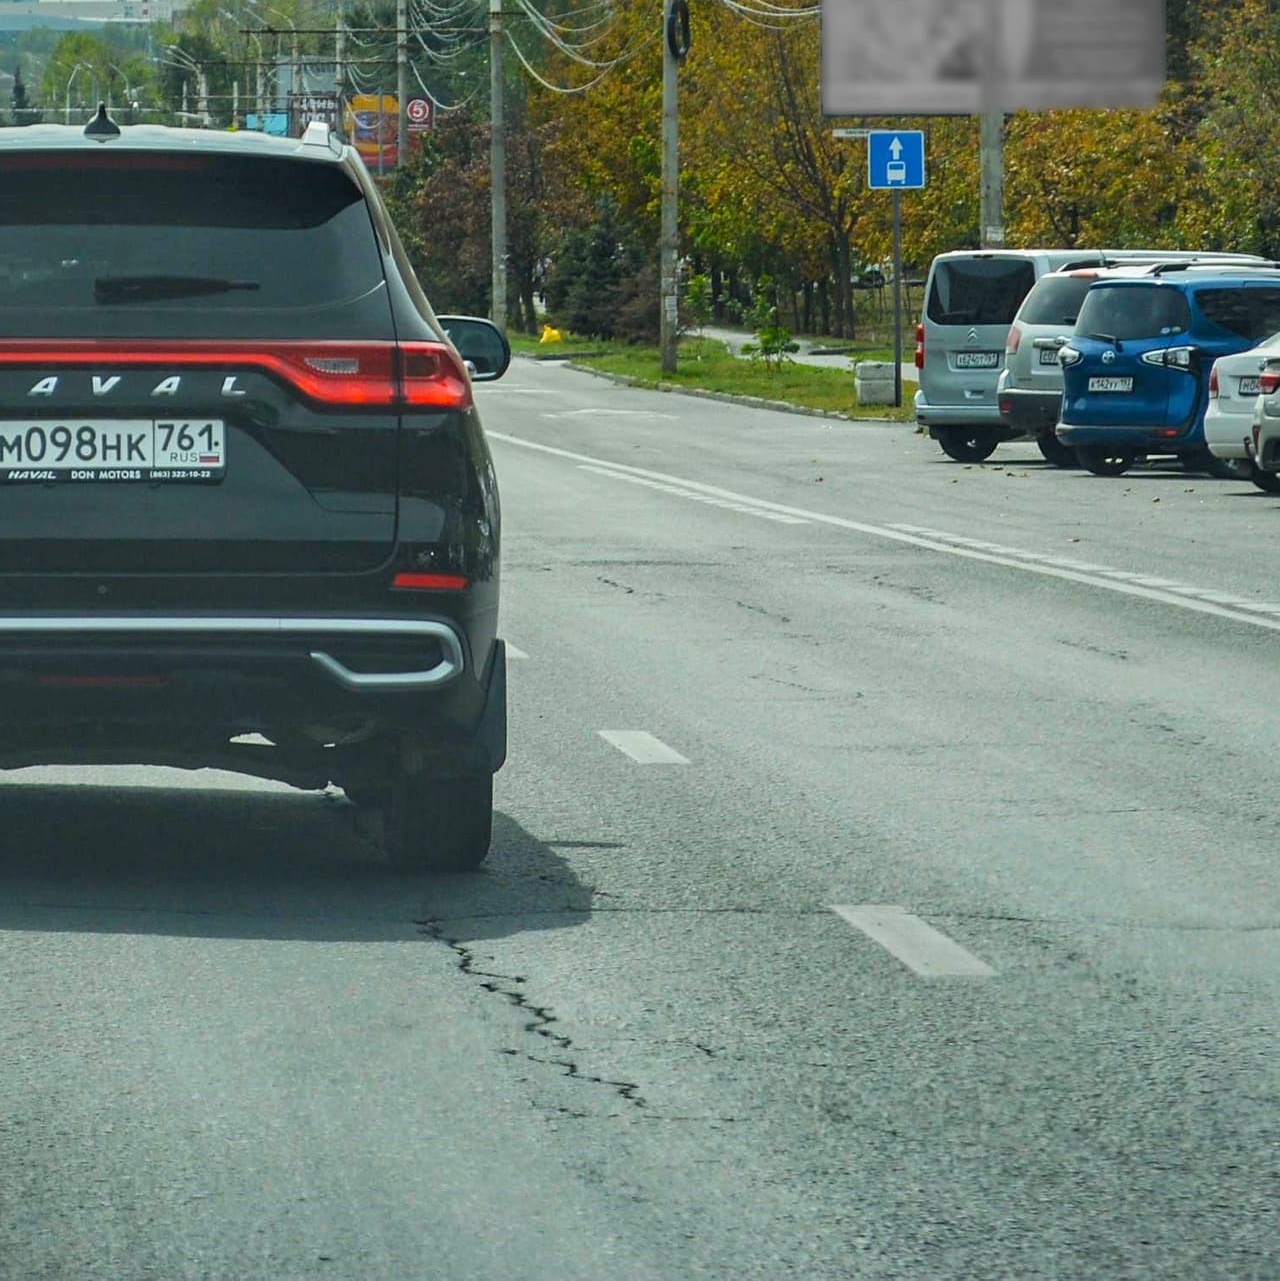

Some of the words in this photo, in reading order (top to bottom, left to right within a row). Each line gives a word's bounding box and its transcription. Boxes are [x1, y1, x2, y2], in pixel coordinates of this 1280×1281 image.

[157, 424, 213, 452] 761
[170, 452, 198, 463] RUS
[8, 471, 57, 480] HAVAL
[71, 470, 95, 479] DON
[99, 470, 141, 479] MOTORS
